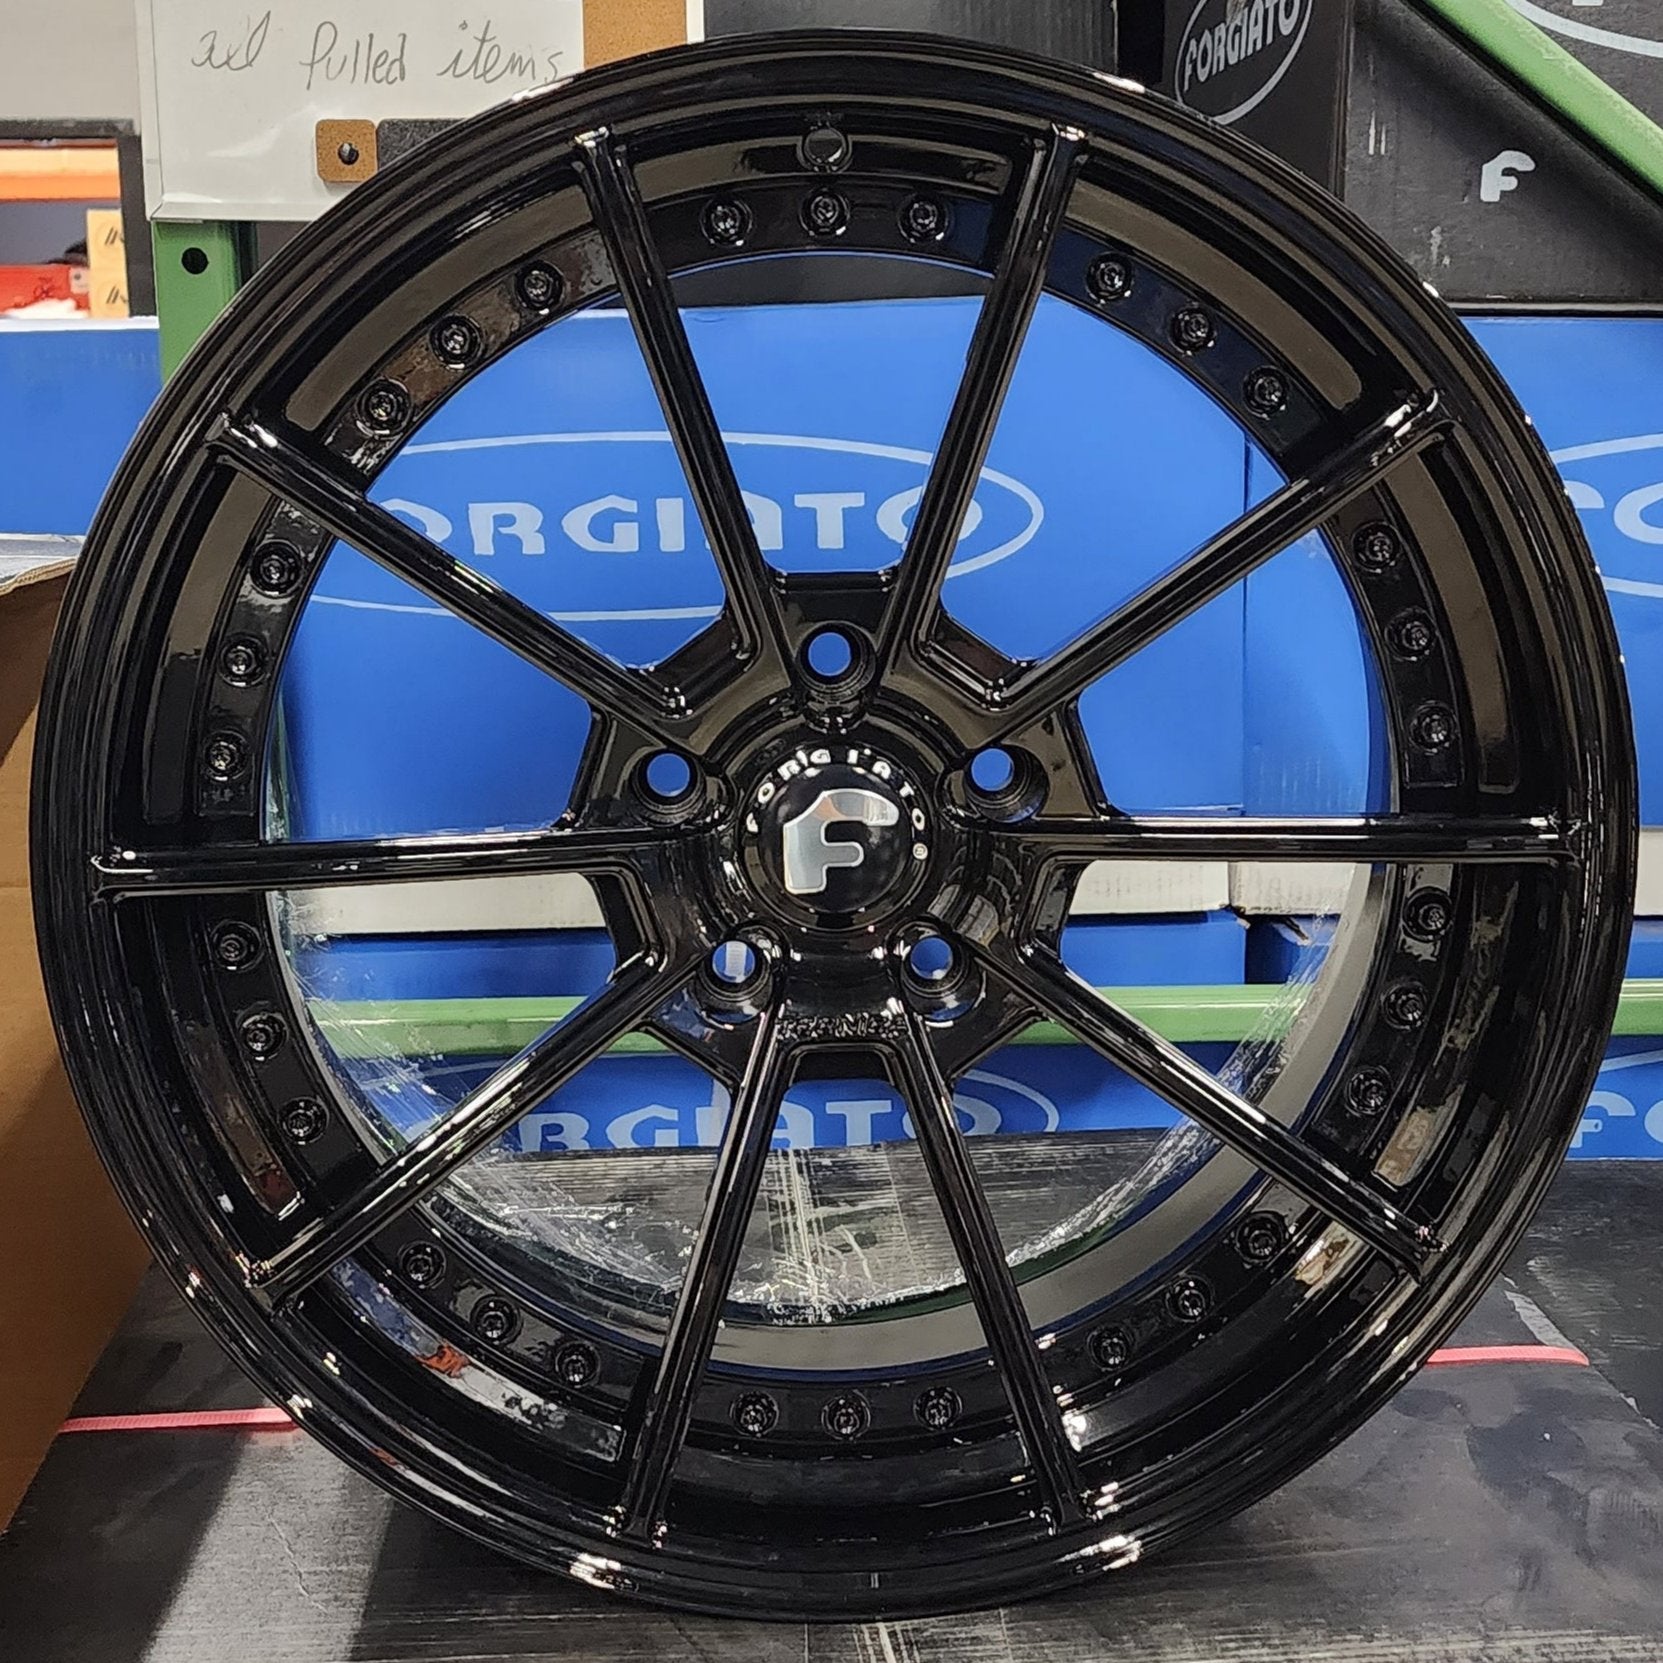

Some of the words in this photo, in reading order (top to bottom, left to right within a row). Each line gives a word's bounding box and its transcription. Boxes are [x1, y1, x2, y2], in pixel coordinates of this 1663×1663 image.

[436, 20, 563, 84] items
[1184, 0, 1301, 93] FORGIATO
[1480, 150, 1535, 202] F
